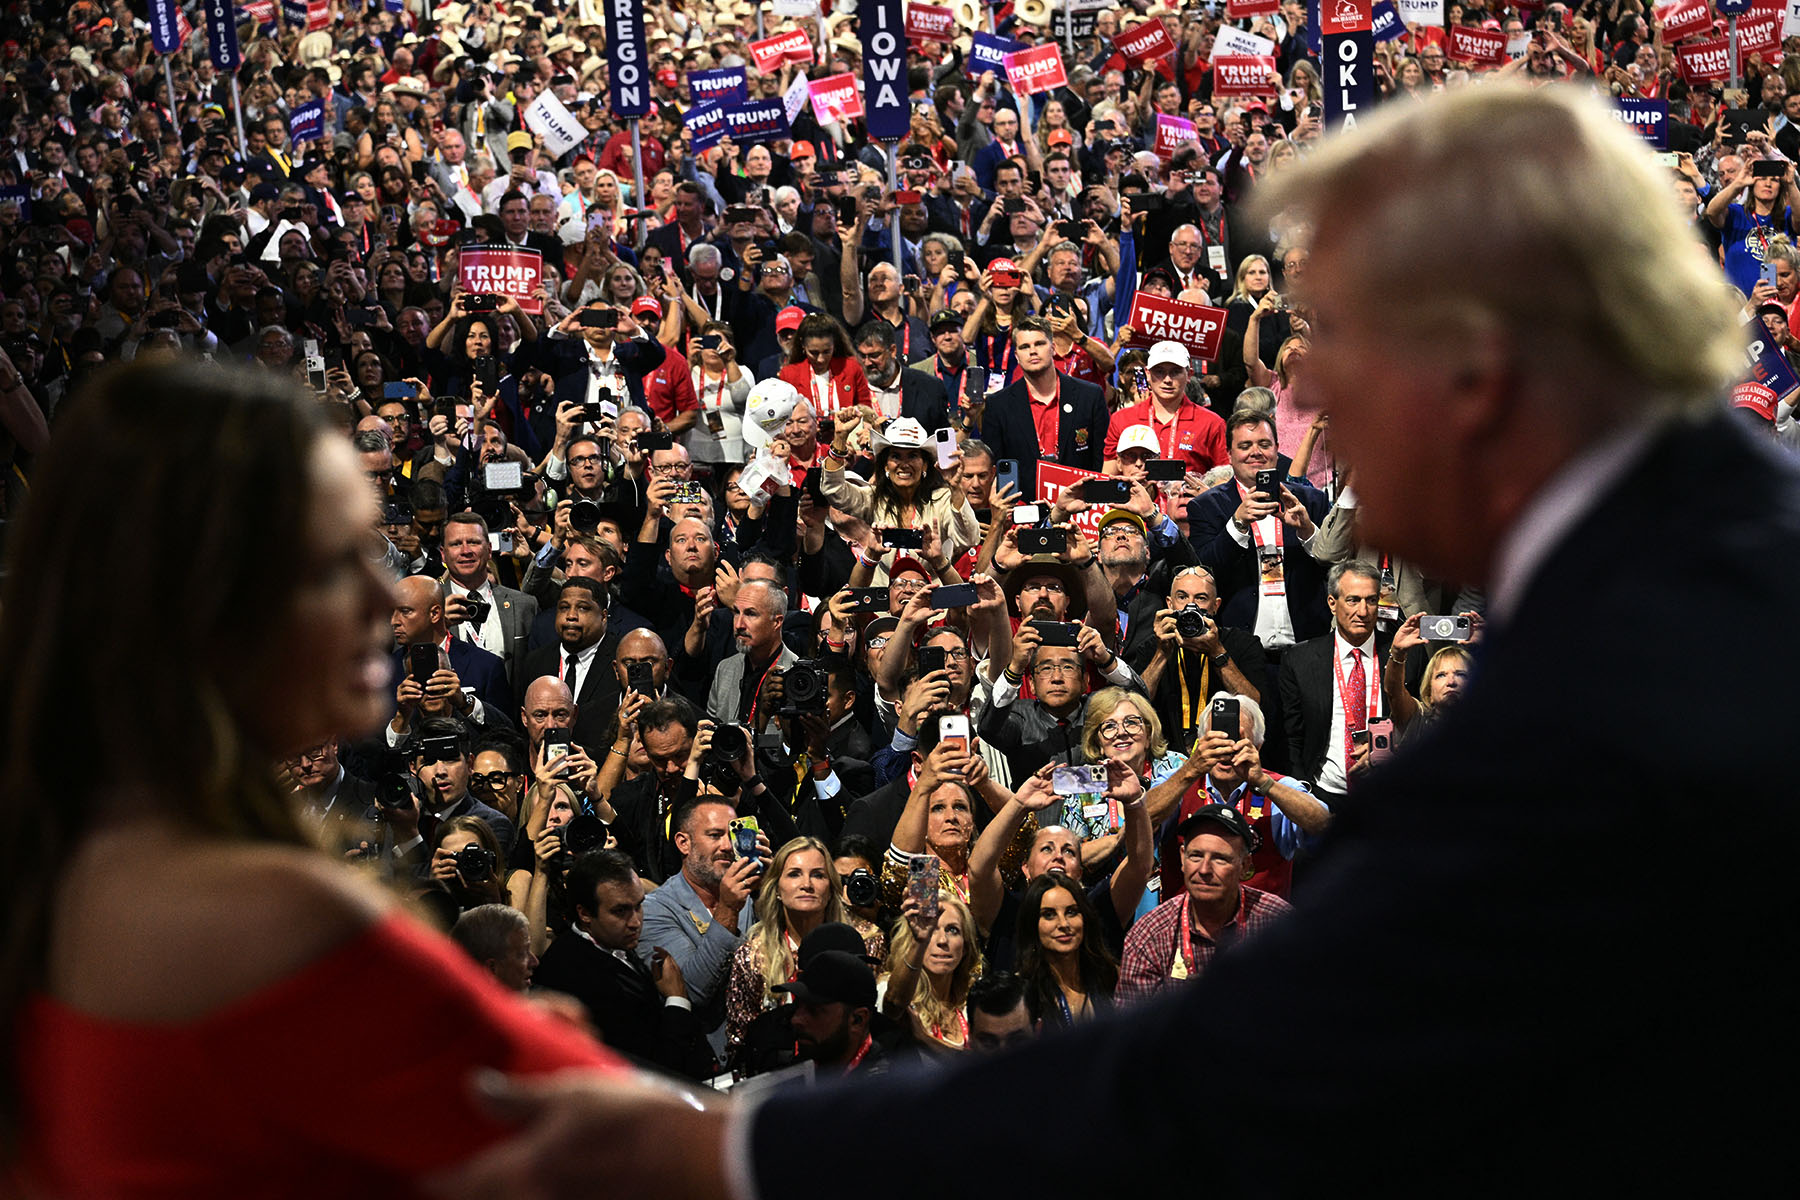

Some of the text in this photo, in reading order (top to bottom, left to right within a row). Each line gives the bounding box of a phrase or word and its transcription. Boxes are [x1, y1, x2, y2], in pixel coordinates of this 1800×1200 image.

[1400, 0, 1439, 10] TRUMP
[156, 0, 171, 47] RSEY
[909, 10, 950, 24] TRUMP
[1663, 5, 1707, 28] TRUMP
[912, 20, 946, 32] VANCE
[1055, 25, 1092, 36] BUE
[216, 22, 230, 64] RICO
[756, 35, 805, 57] TRUMP
[1120, 29, 1164, 56] TRUMP
[1454, 32, 1503, 50] TRUMP
[1741, 32, 1772, 48] ANCE
[868, 5, 901, 108] IOWA
[974, 43, 1007, 61] TRU
[1458, 43, 1497, 57] VANCE
[1683, 48, 1730, 65] TRUM
[1008, 57, 1058, 80] TRUMP
[1218, 65, 1273, 77] TRUMP
[691, 75, 743, 92] TRUMP
[1224, 76, 1266, 85] VANCE
[813, 87, 854, 106] TRUMP
[291, 107, 321, 129] TRUMP
[537, 103, 573, 142] TRUMP
[726, 108, 782, 126] TRUMP
[1610, 109, 1662, 124] RUMP
[733, 121, 777, 134] VANCE
[464, 265, 537, 281] TRUMP
[471, 280, 529, 294] VANCE
[1138, 306, 1217, 334] TRUMP
[1144, 323, 1207, 344] VANCE
[1129, 427, 1149, 441] 47
[1178, 443, 1193, 451] RNC
